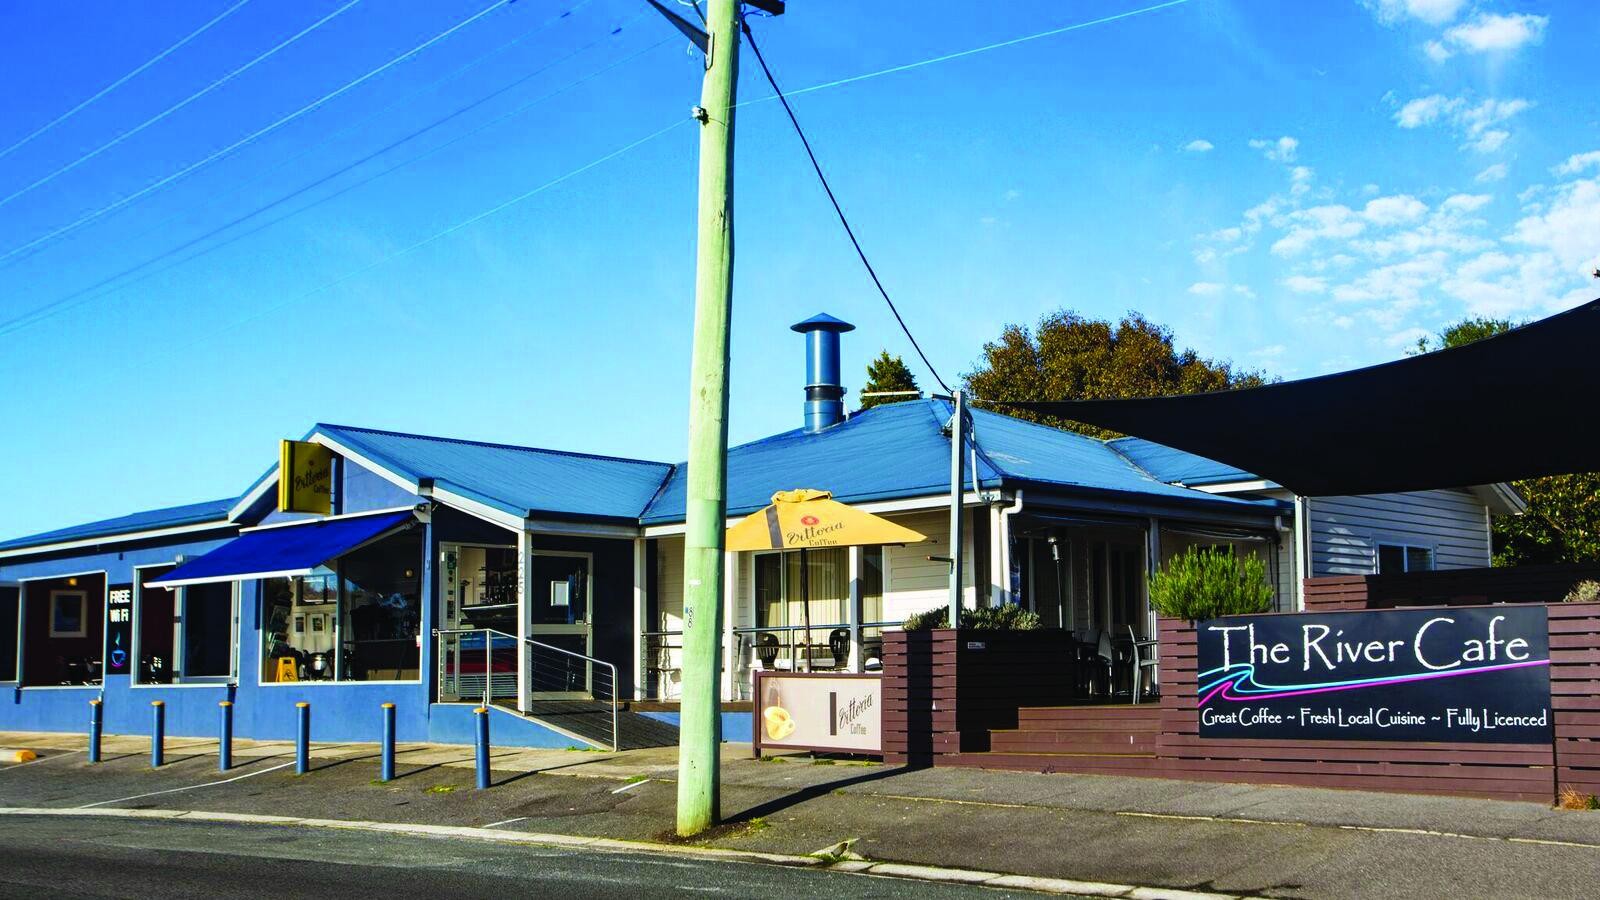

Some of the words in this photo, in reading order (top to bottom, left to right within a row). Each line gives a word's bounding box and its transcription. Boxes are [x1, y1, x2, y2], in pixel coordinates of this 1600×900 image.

[786, 521, 845, 545] Vittoria
[809, 538, 838, 547] Coffee
[109, 589, 131, 604] FREE
[1207, 622, 1290, 672] The
[1302, 624, 1405, 672] River
[1413, 615, 1530, 671] Cafe
[839, 693, 873, 730] Vittoria
[1201, 708, 1237, 727] Great
[1238, 707, 1283, 727] Coffee
[1300, 707, 1336, 727] Fresh
[1338, 707, 1374, 727] Local
[1375, 707, 1426, 727] Cuisine
[1447, 708, 1481, 732] Fully
[1483, 708, 1547, 729] Licenced
[850, 723, 867, 736] Coffee
